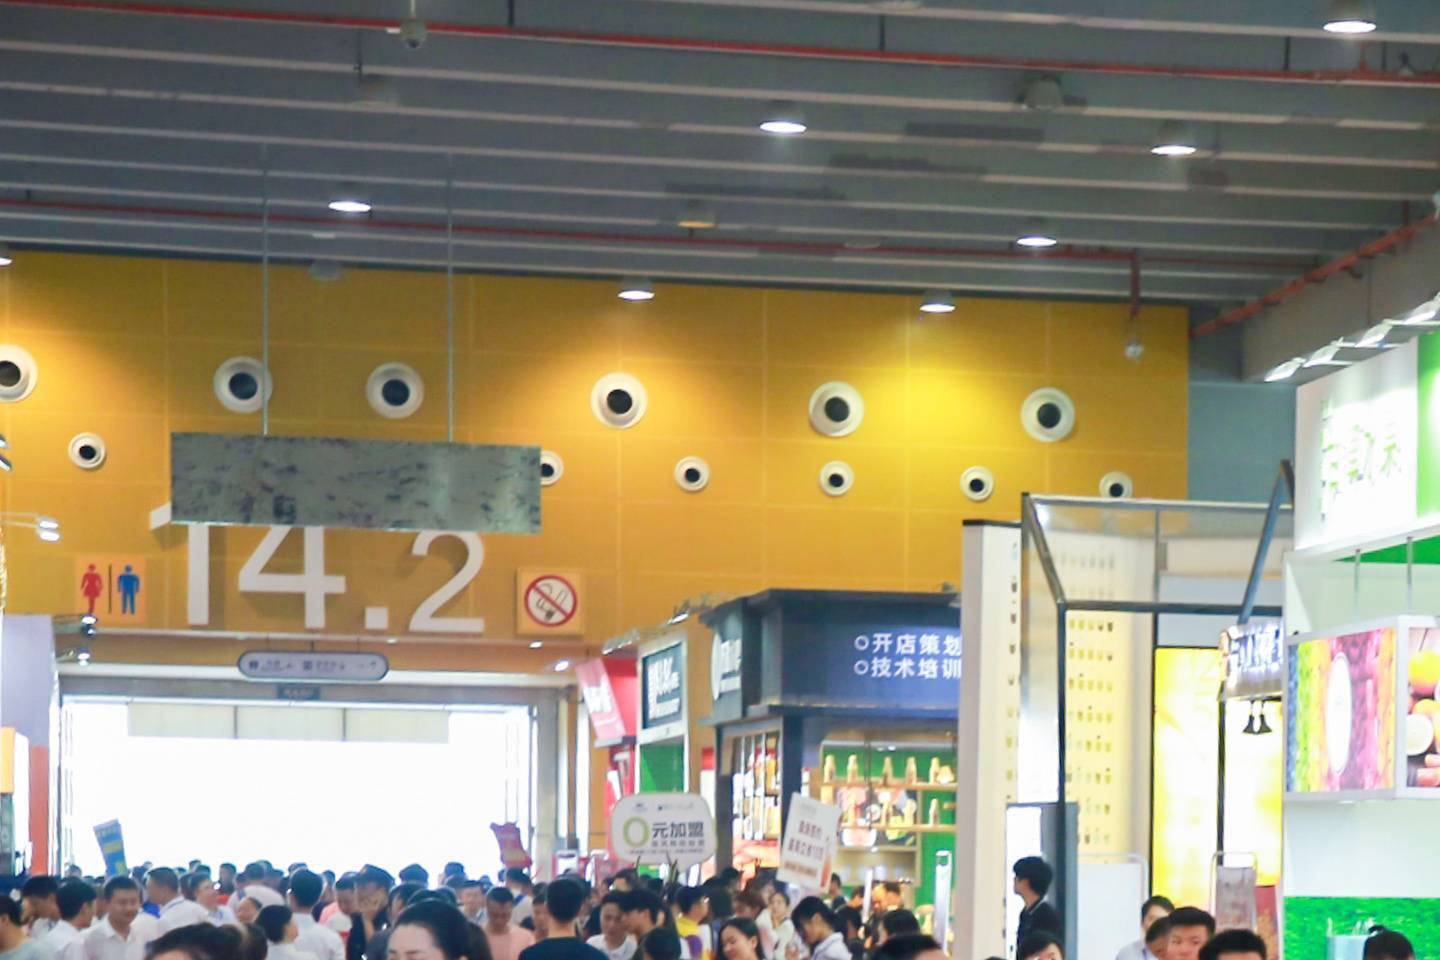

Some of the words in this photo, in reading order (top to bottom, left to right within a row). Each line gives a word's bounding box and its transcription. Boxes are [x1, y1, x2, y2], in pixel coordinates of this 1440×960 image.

[150, 503, 486, 633] 14.2
[872, 632, 962, 656] 开店策划
[871, 656, 962, 679] 技术培训
